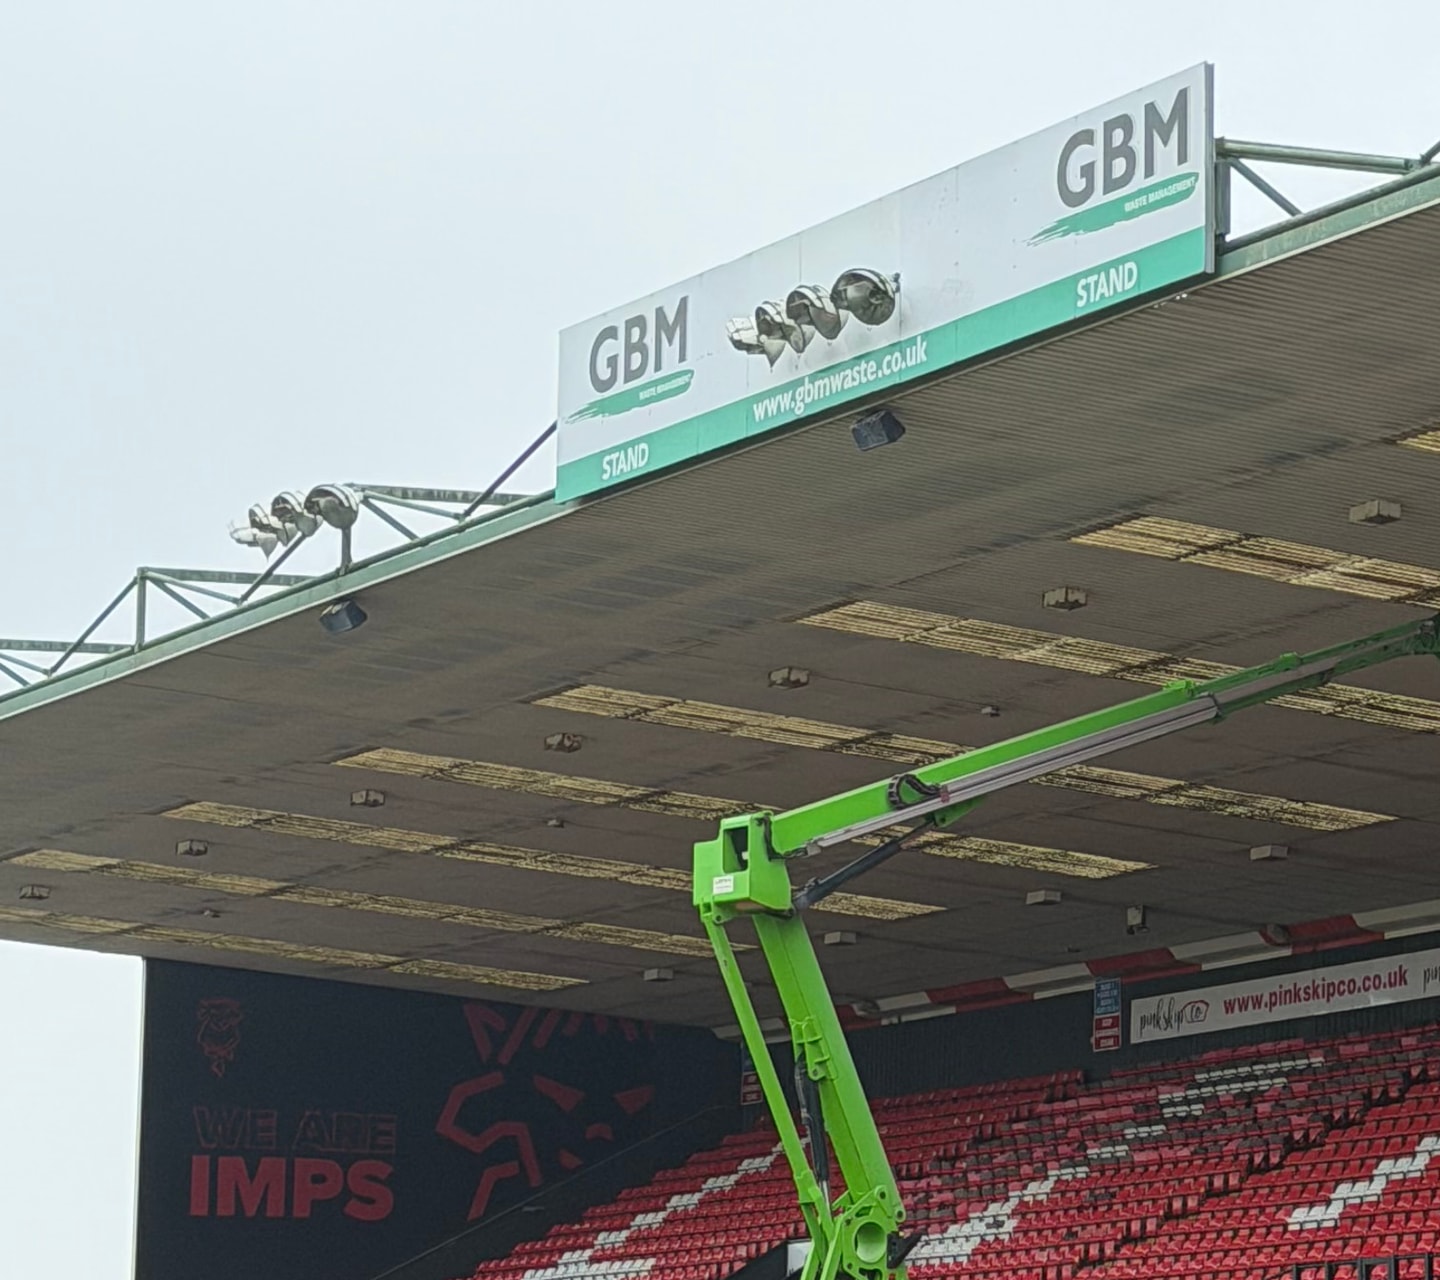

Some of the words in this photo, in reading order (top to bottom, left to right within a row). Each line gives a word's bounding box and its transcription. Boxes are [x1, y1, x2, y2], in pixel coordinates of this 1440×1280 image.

[1056, 86, 1191, 208] GBM
[1124, 194, 1148, 212] WASTE
[1148, 176, 1196, 204] MANAGEMENT
[1075, 261, 1138, 308] STAND
[588, 296, 689, 394] GBM
[753, 336, 927, 423] www.gbmwaste.co.uk
[601, 443, 649, 481] STAND
[1223, 964, 1408, 1015] www.pinkskipco.co.uk
[192, 1106, 279, 1150] WE
[291, 1108, 398, 1155] ARE
[189, 1154, 395, 1222] IMPS
